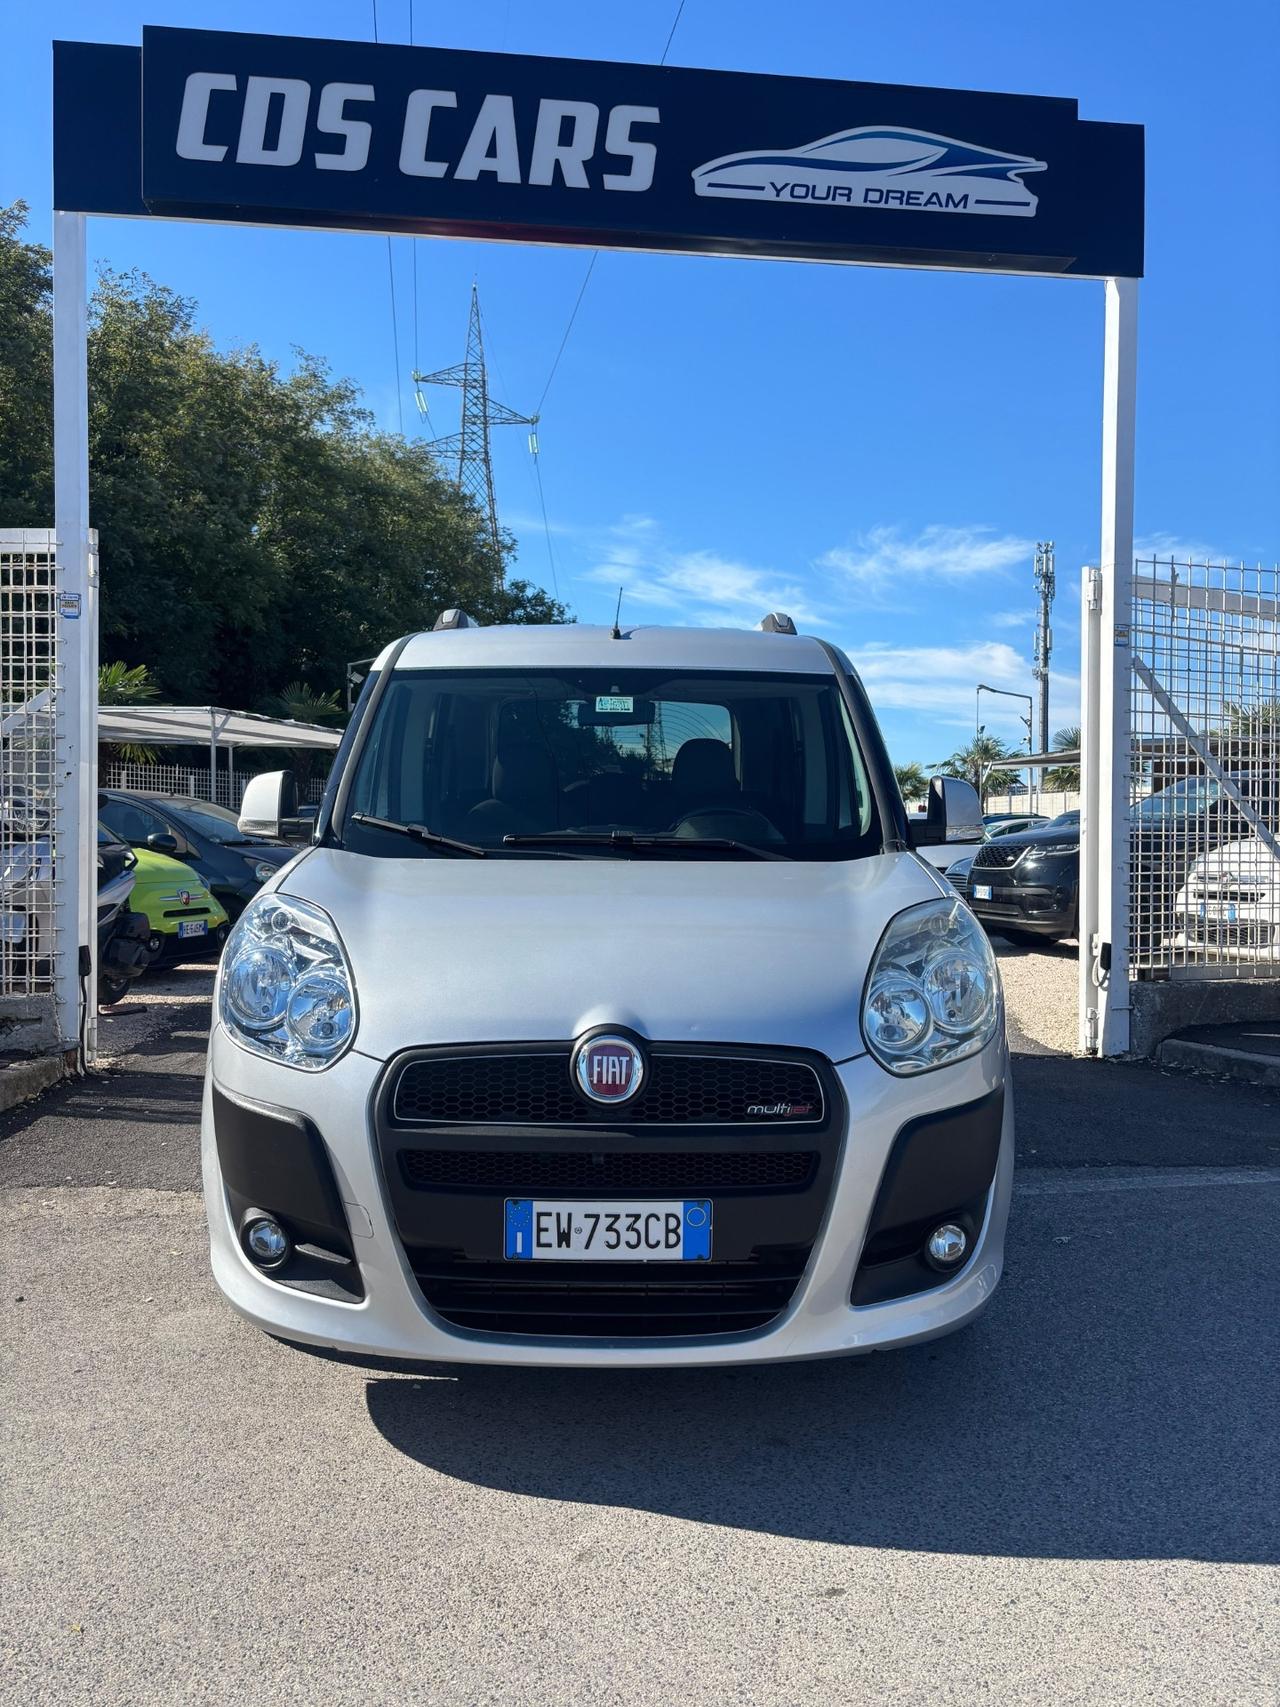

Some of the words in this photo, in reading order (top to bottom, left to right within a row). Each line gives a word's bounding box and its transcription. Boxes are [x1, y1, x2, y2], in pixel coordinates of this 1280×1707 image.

[176, 71, 375, 172] CDS
[398, 88, 661, 192] CARS
[769, 181, 853, 202] YOUR
[863, 188, 970, 209] DREAM
[592, 1055, 630, 1086] FIAT
[746, 1102, 814, 1117] multijet
